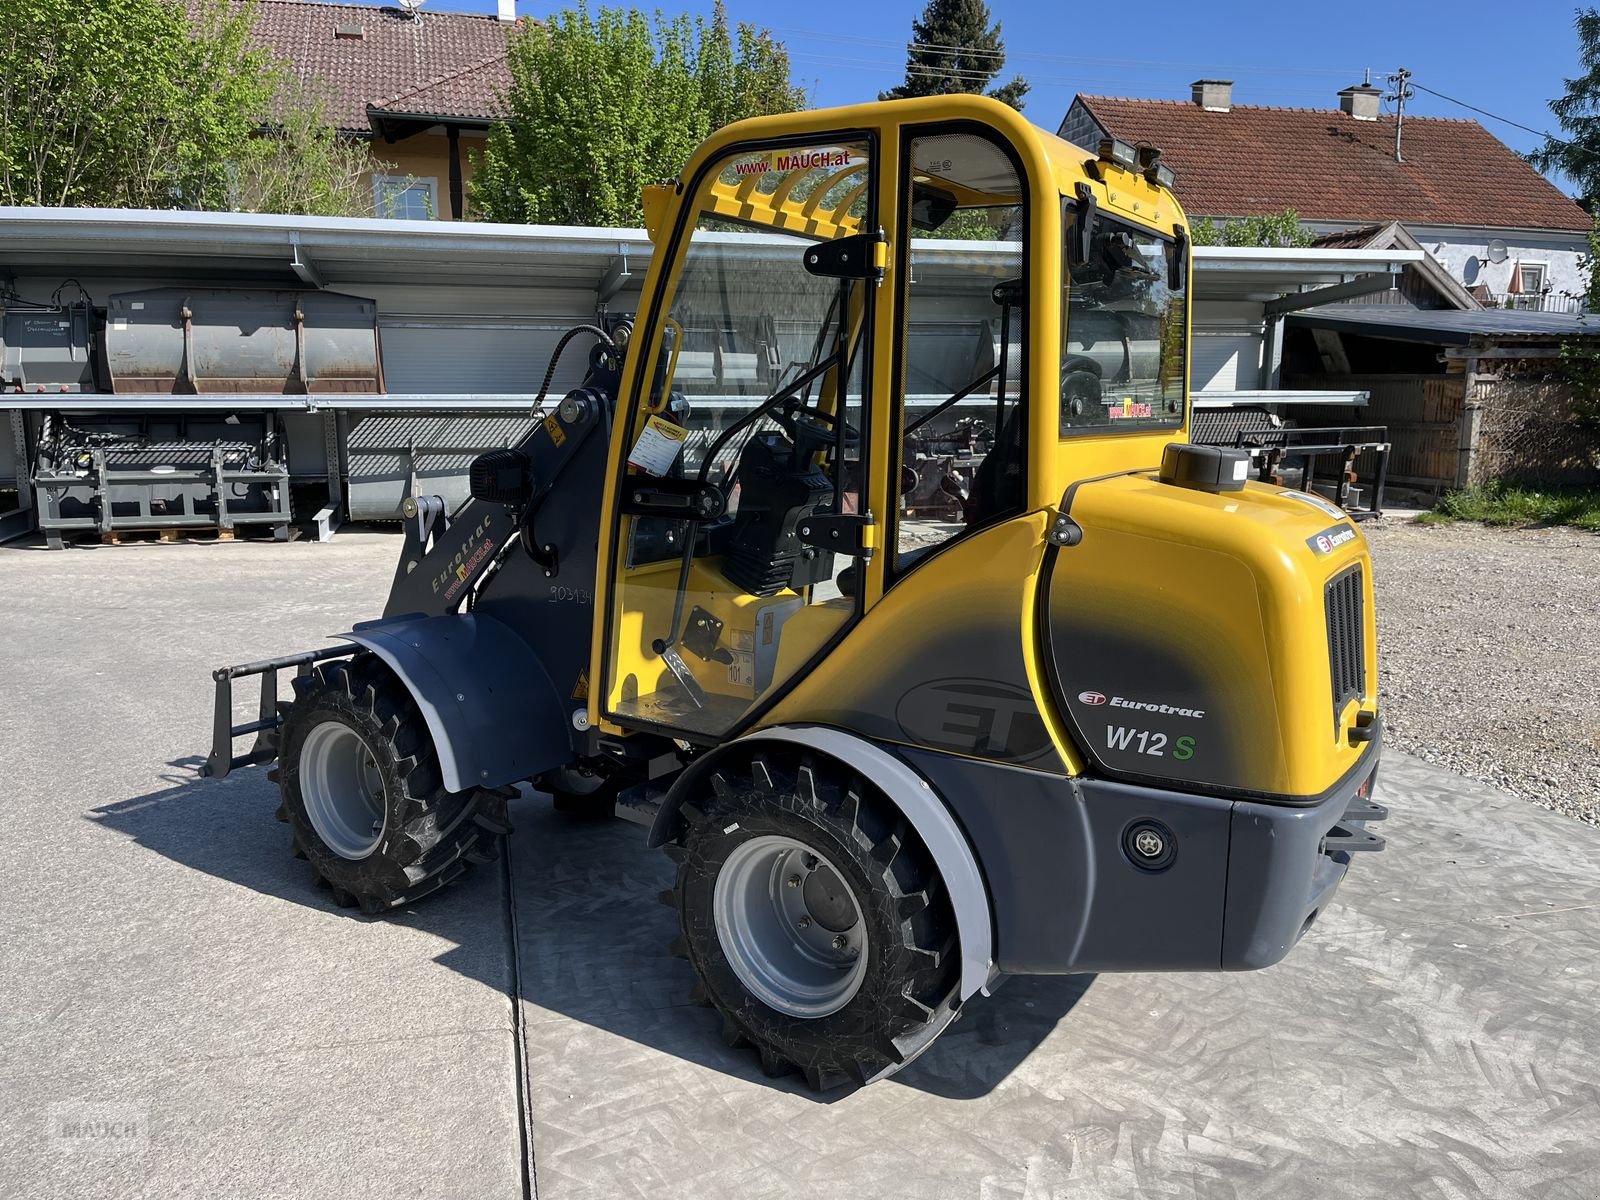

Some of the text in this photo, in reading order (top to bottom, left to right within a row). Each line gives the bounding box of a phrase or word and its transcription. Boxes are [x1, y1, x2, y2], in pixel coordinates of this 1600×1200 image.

[431, 514, 491, 593] Eurotrac
[1079, 691, 1205, 718] ET Eurotrac
[1106, 724, 1196, 761] W12 S
